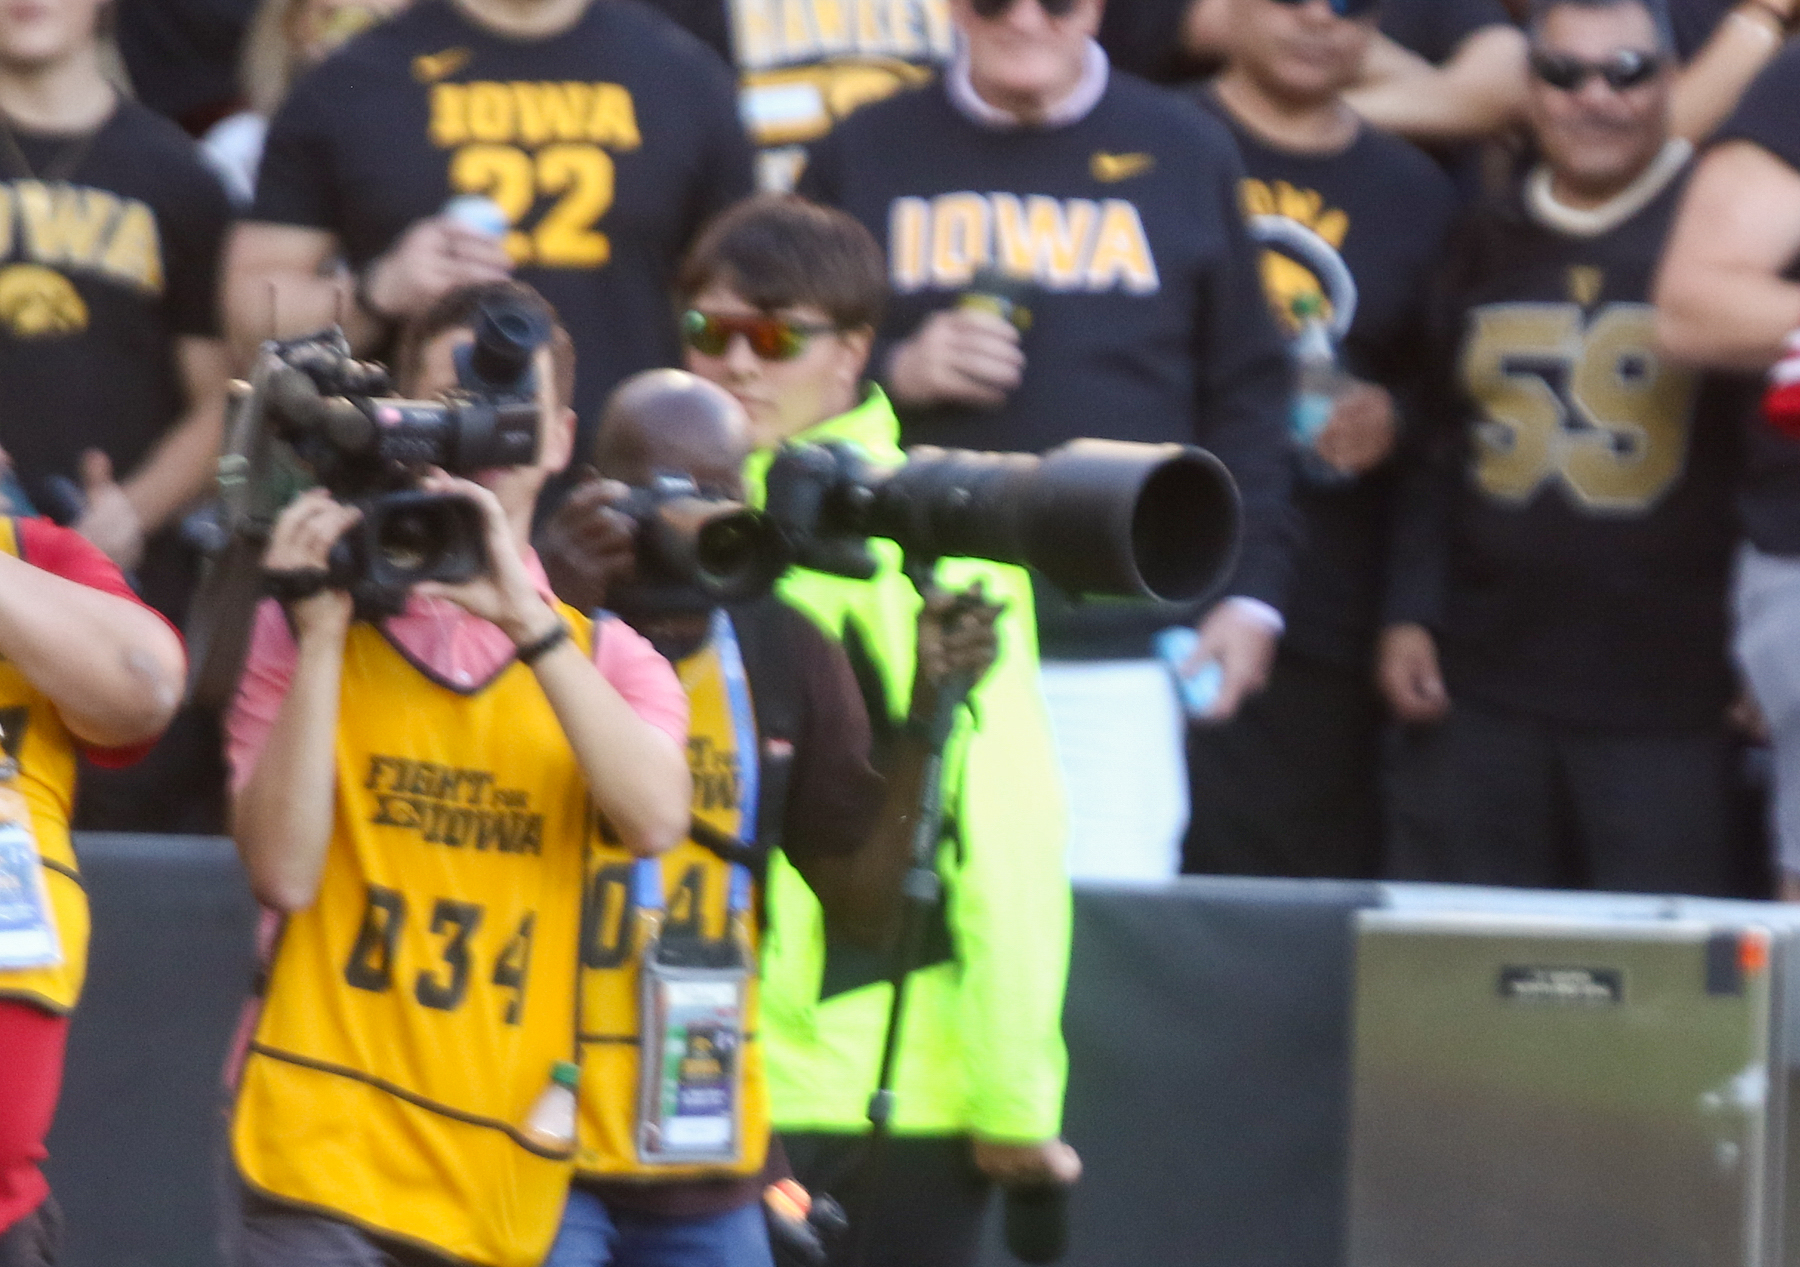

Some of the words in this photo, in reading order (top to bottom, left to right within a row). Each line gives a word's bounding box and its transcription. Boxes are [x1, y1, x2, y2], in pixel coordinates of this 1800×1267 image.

[431, 80, 641, 150] IOWA
[452, 143, 614, 267] 22
[887, 190, 1161, 295] IOWA
[1462, 303, 1697, 508] 59
